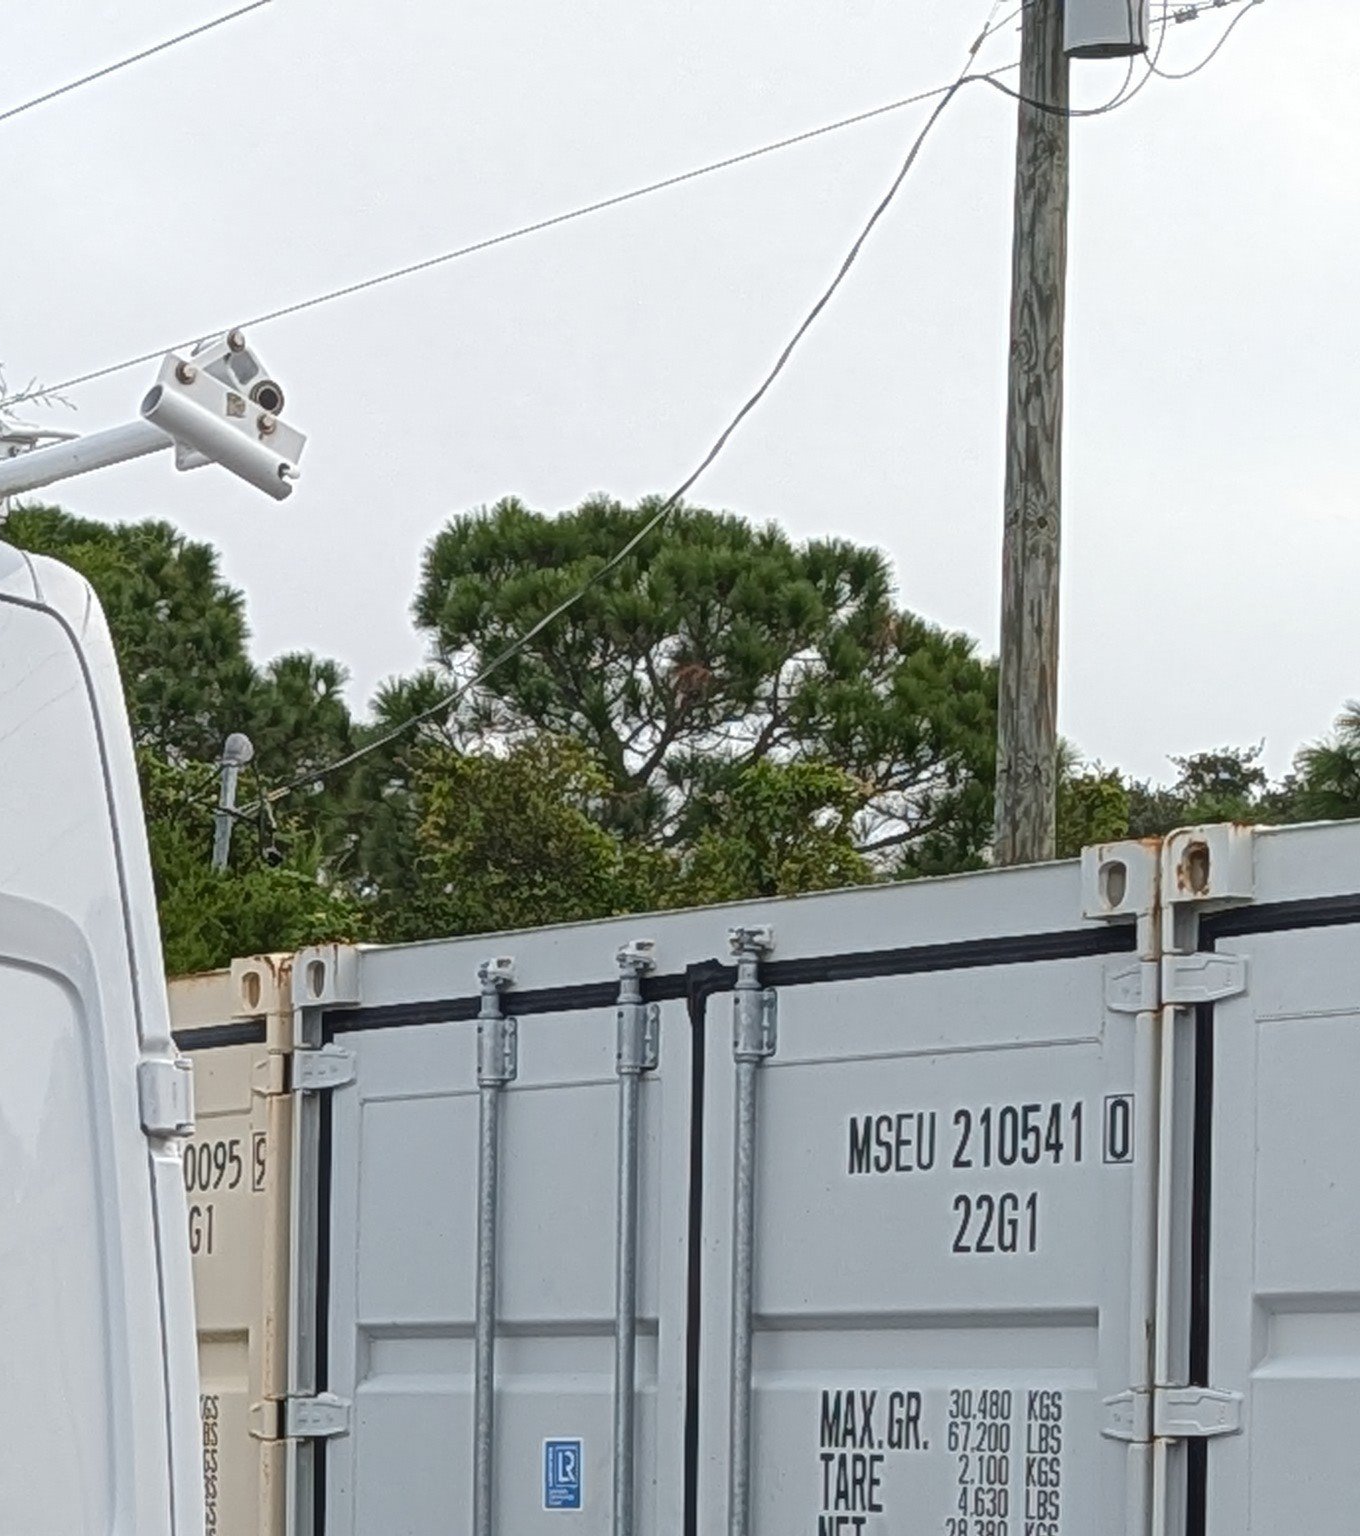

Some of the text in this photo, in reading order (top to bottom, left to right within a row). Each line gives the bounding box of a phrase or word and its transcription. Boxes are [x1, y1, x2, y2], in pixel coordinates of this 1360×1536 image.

[848, 1097, 1130, 1175] MSEU 210541 0
[952, 1191, 1039, 1254] 22G1
[819, 1389, 929, 1451] MAX.GR.
[948, 1388, 1063, 1422] 30.480 KGS
[947, 1421, 1062, 1455] 67.200 LBS
[819, 1452, 884, 1513] TARE
[958, 1454, 1061, 1488] 2.100 KGS
[957, 1487, 1060, 1521] 4.630 LBS
